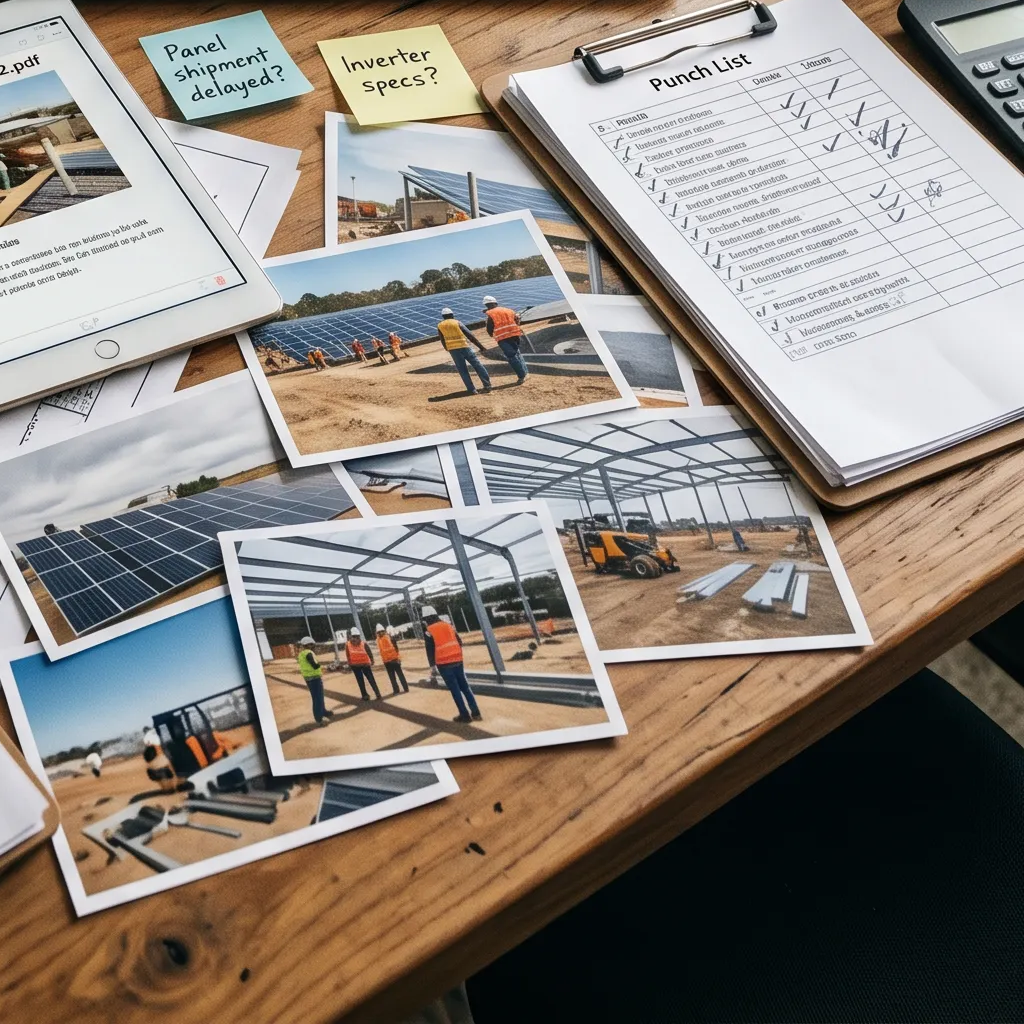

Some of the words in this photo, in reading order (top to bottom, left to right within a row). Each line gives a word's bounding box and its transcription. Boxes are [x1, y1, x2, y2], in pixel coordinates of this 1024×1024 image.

[164, 35, 227, 62] Panel
[174, 46, 269, 84] shipment
[340, 46, 431, 74] Inverter
[190, 64, 286, 104] delayed?
[362, 66, 439, 97] specs?
[649, 63, 713, 93] Punch
[712, 52, 752, 75] List
